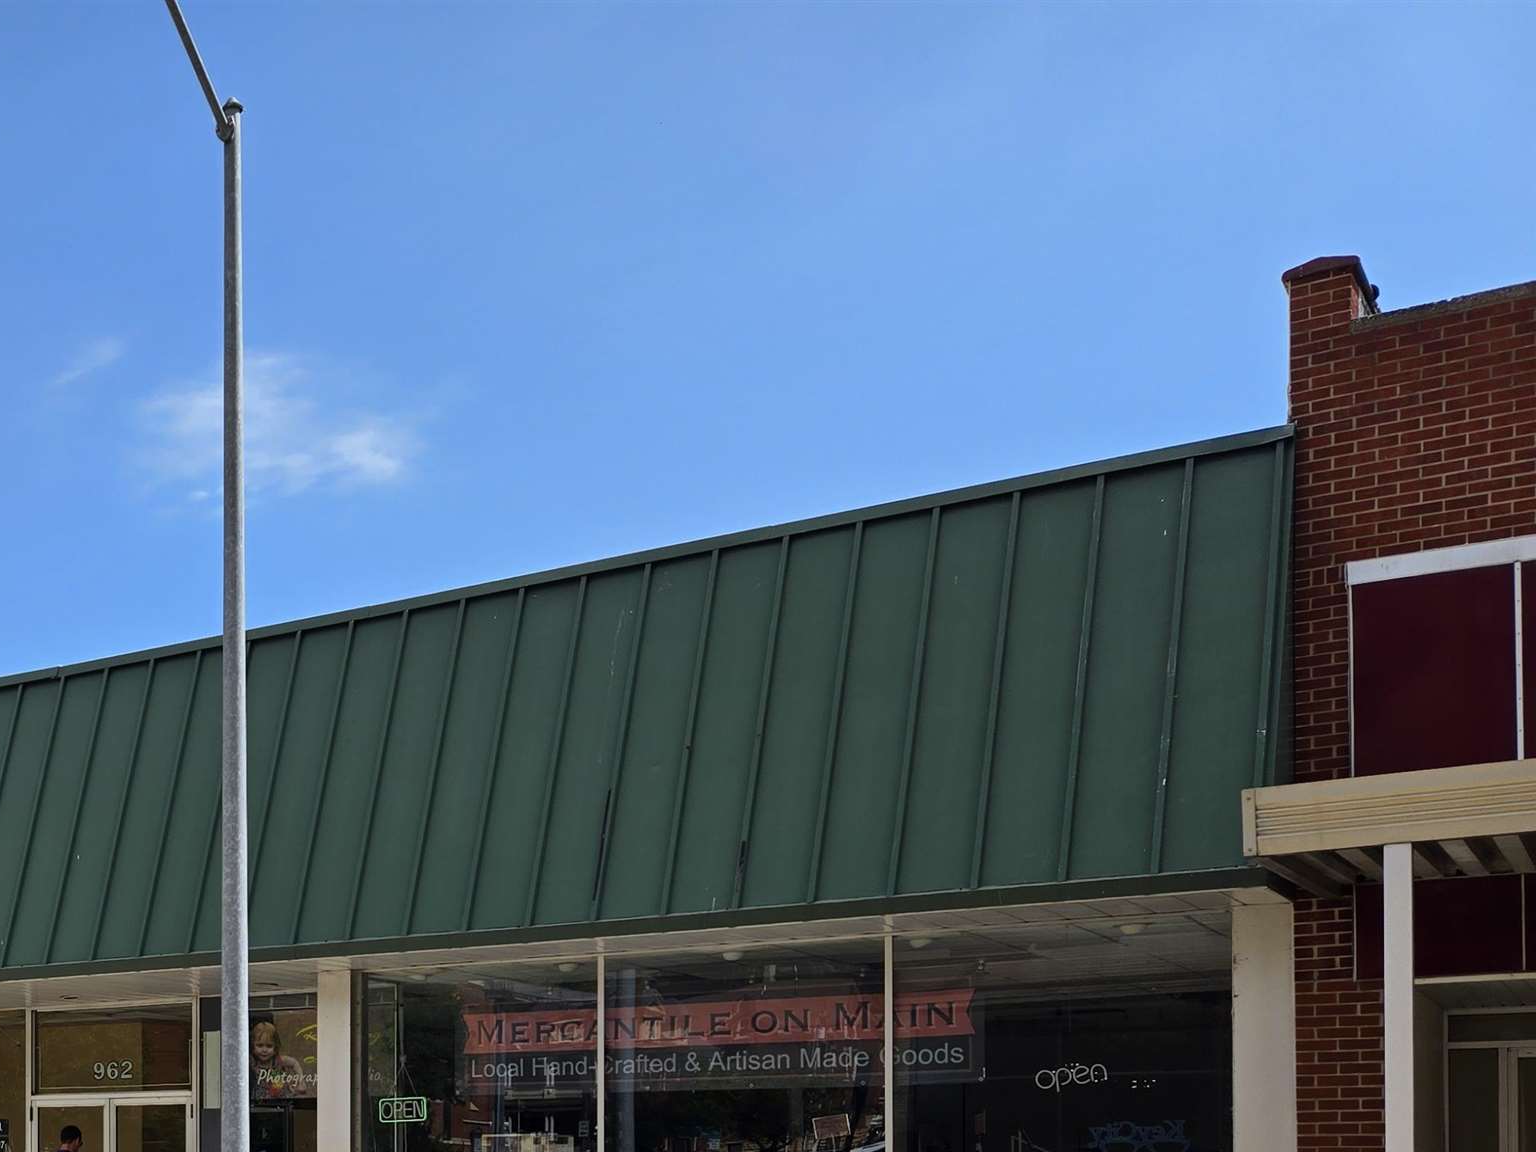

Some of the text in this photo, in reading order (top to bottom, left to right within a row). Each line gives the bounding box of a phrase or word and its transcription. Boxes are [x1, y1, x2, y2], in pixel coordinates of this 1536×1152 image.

[477, 1000, 956, 1045] MERCANTILE ON MAIN
[94, 1060, 133, 1080] 962
[471, 1057, 524, 1078] Local
[684, 1051, 700, 1072] &
[708, 1050, 791, 1072] Artisan
[800, 1046, 870, 1069] Made
[1035, 1063, 1108, 1093] open
[381, 1100, 424, 1119] OPEN
